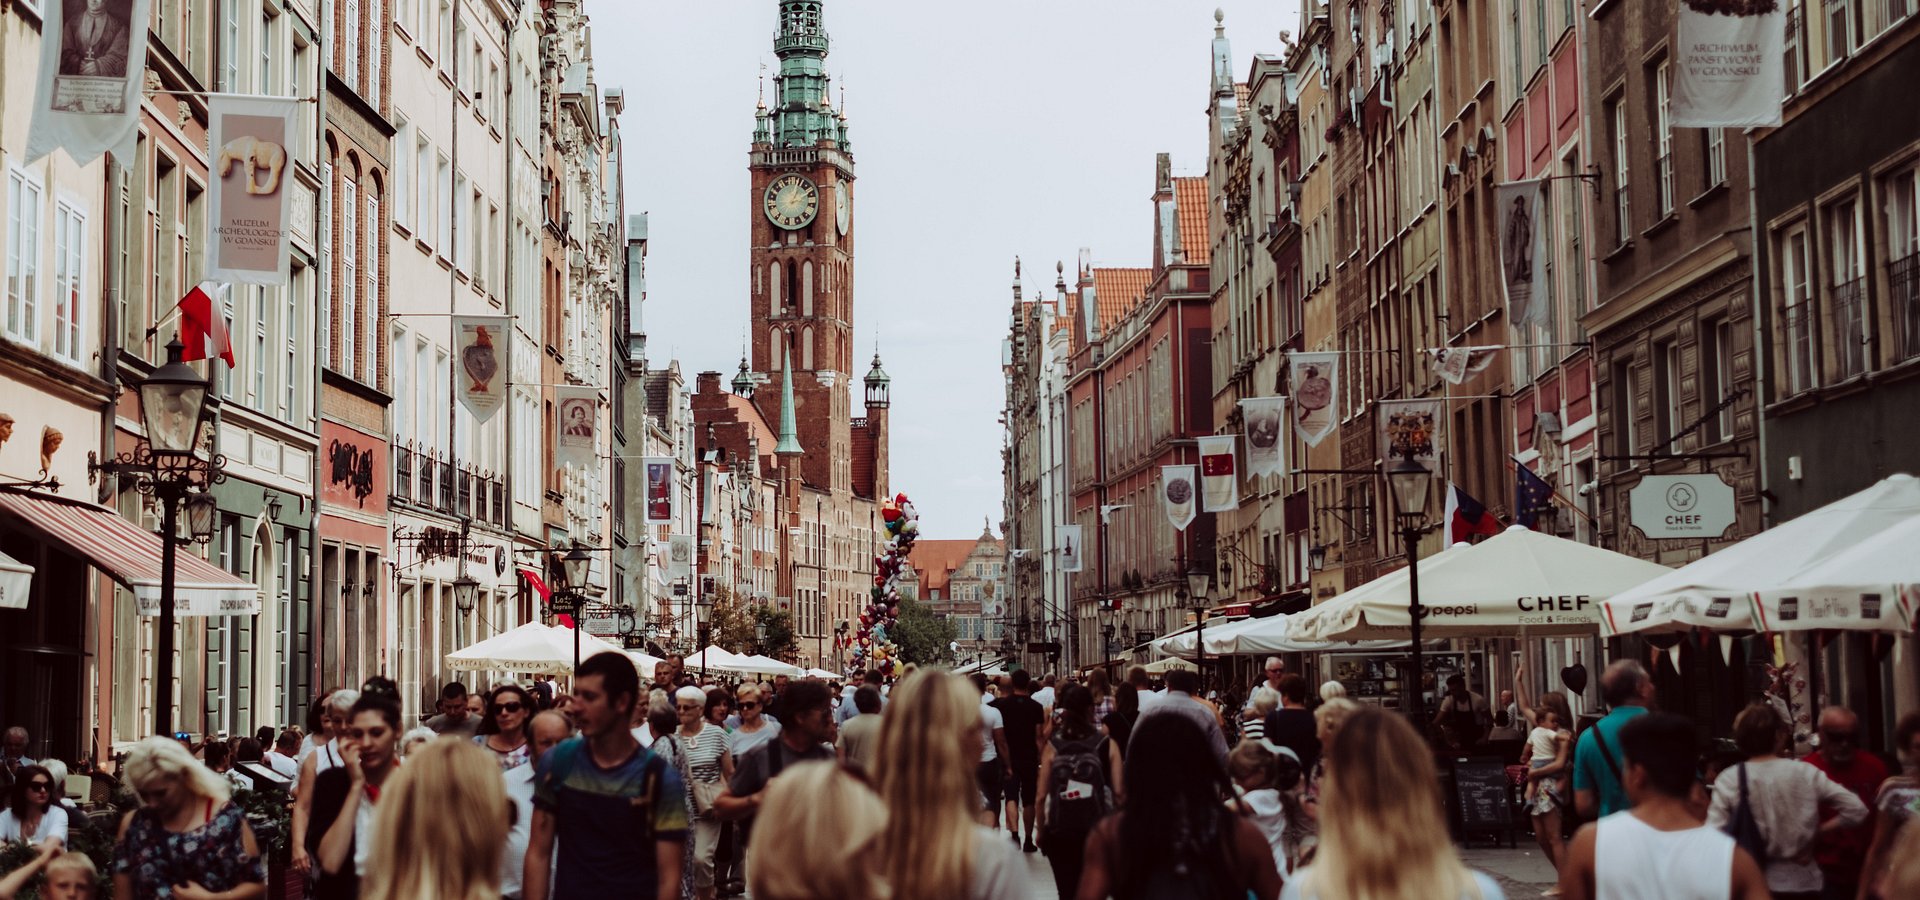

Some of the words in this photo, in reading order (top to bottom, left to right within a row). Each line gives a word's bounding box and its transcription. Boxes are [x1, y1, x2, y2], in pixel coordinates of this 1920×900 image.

[1692, 43, 1759, 53] ARCHIWUM
[1689, 66, 1700, 77] W
[231, 219, 270, 228] MUZEUM
[212, 226, 287, 238] ARCHEOLOGICZNE
[223, 236, 233, 244] W
[1665, 515, 1702, 525] CHEF
[1517, 595, 1590, 612] CHEF
[1432, 603, 1478, 617] pepsi
[1518, 615, 1544, 624] Food
[1546, 615, 1553, 623] &
[1556, 614, 1592, 624] Friends
[504, 661, 550, 669] GRYCAN
[1163, 662, 1187, 671] LODY
[705, 667, 739, 678] ATURALNE
